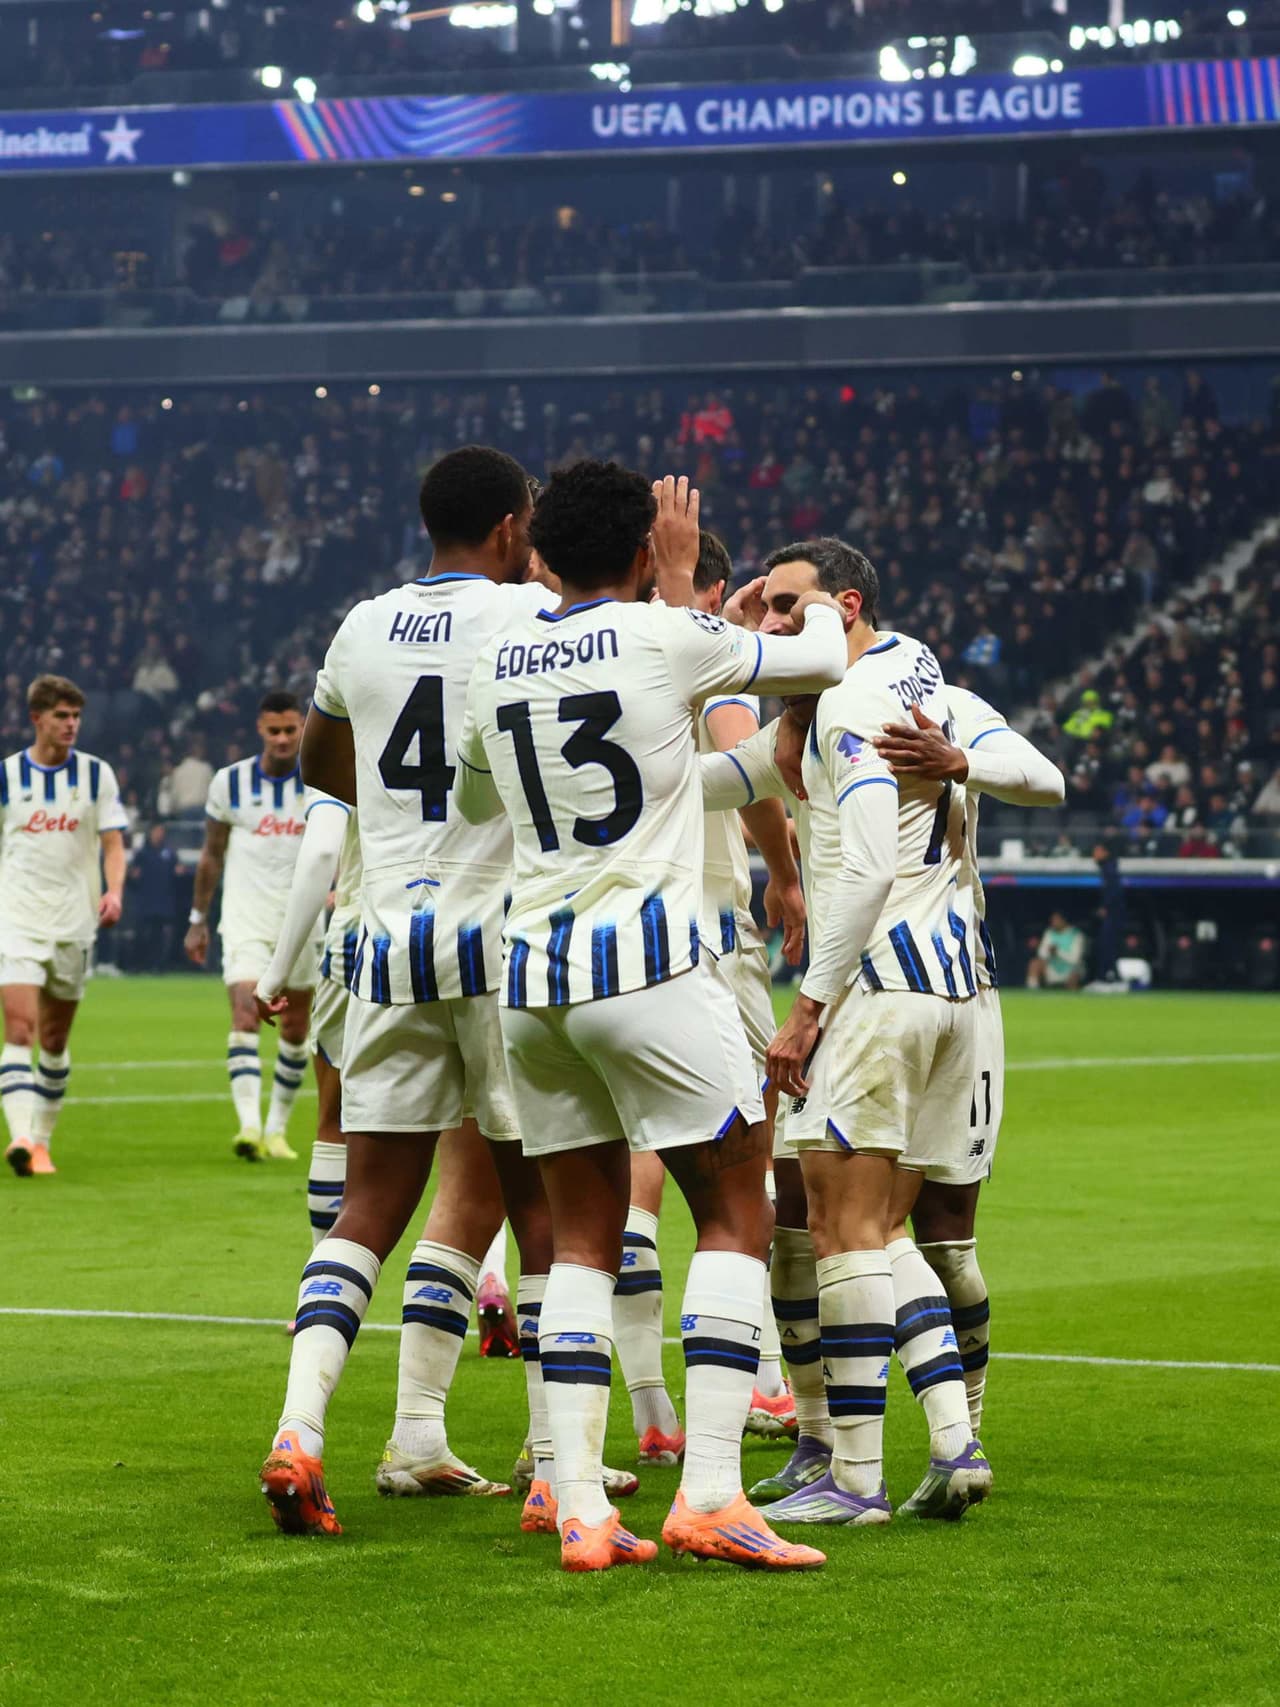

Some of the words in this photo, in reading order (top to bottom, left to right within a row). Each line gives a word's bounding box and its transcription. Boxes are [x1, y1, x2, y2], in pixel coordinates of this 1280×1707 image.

[592, 102, 688, 137] UEFA
[695, 89, 924, 133] CHAMPIONS
[933, 82, 1083, 125] LEAGUE
[388, 610, 452, 643] HIEN
[495, 628, 619, 681] ÉDERSON
[377, 674, 456, 823] 4
[496, 690, 644, 853] 13
[20, 809, 80, 835] Lete
